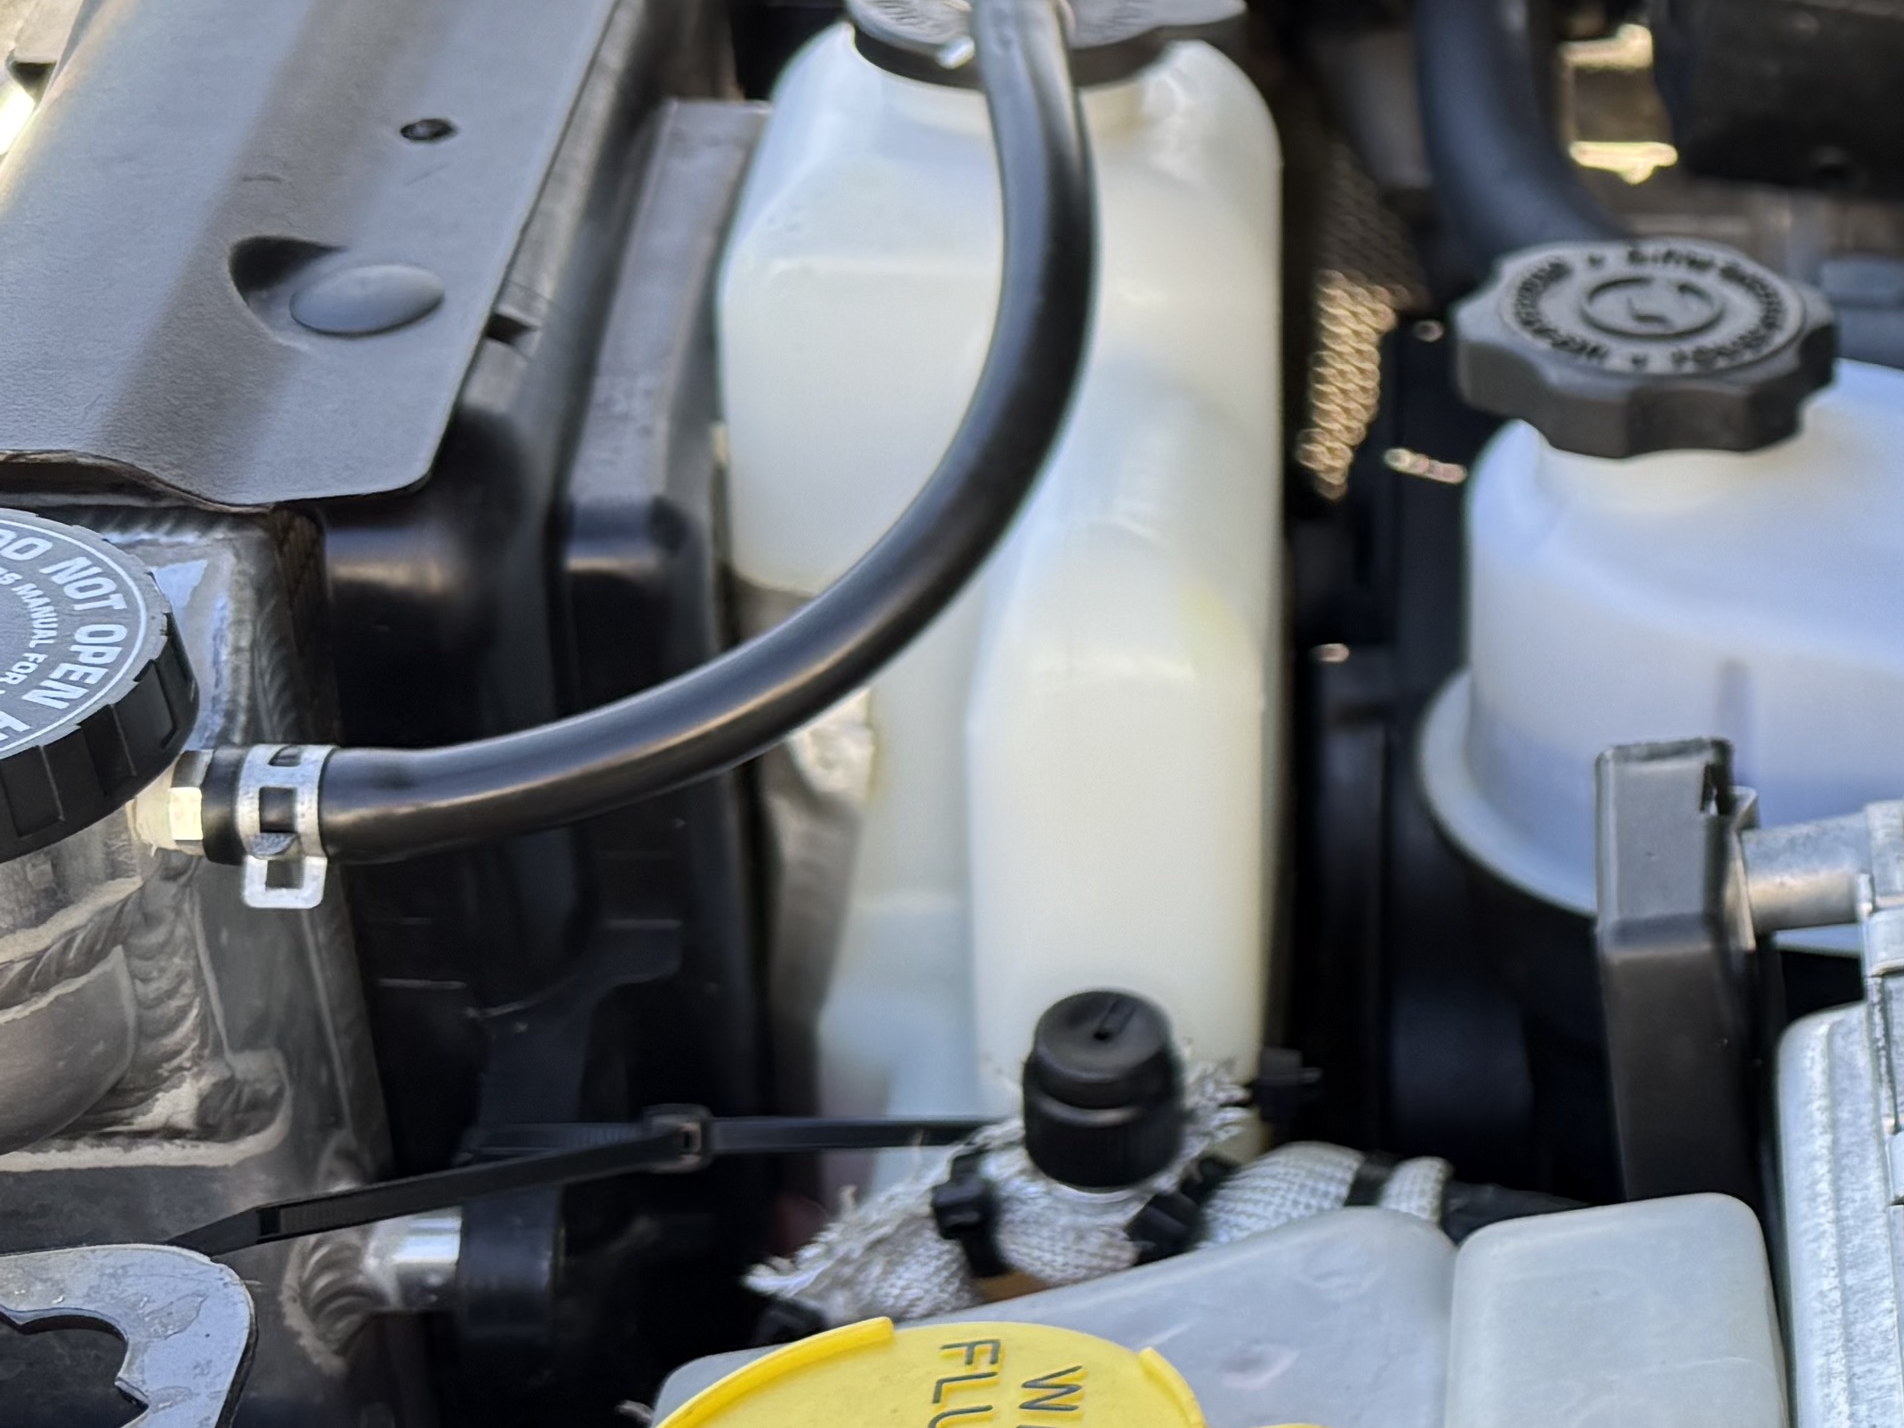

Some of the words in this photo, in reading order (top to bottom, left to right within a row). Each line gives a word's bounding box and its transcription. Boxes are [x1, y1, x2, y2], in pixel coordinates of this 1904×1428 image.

[39, 557, 128, 611] NOT
[11, 582, 59, 649] MANUAL
[0, 652, 48, 685] FOR
[21, 623, 128, 710] OPEN
